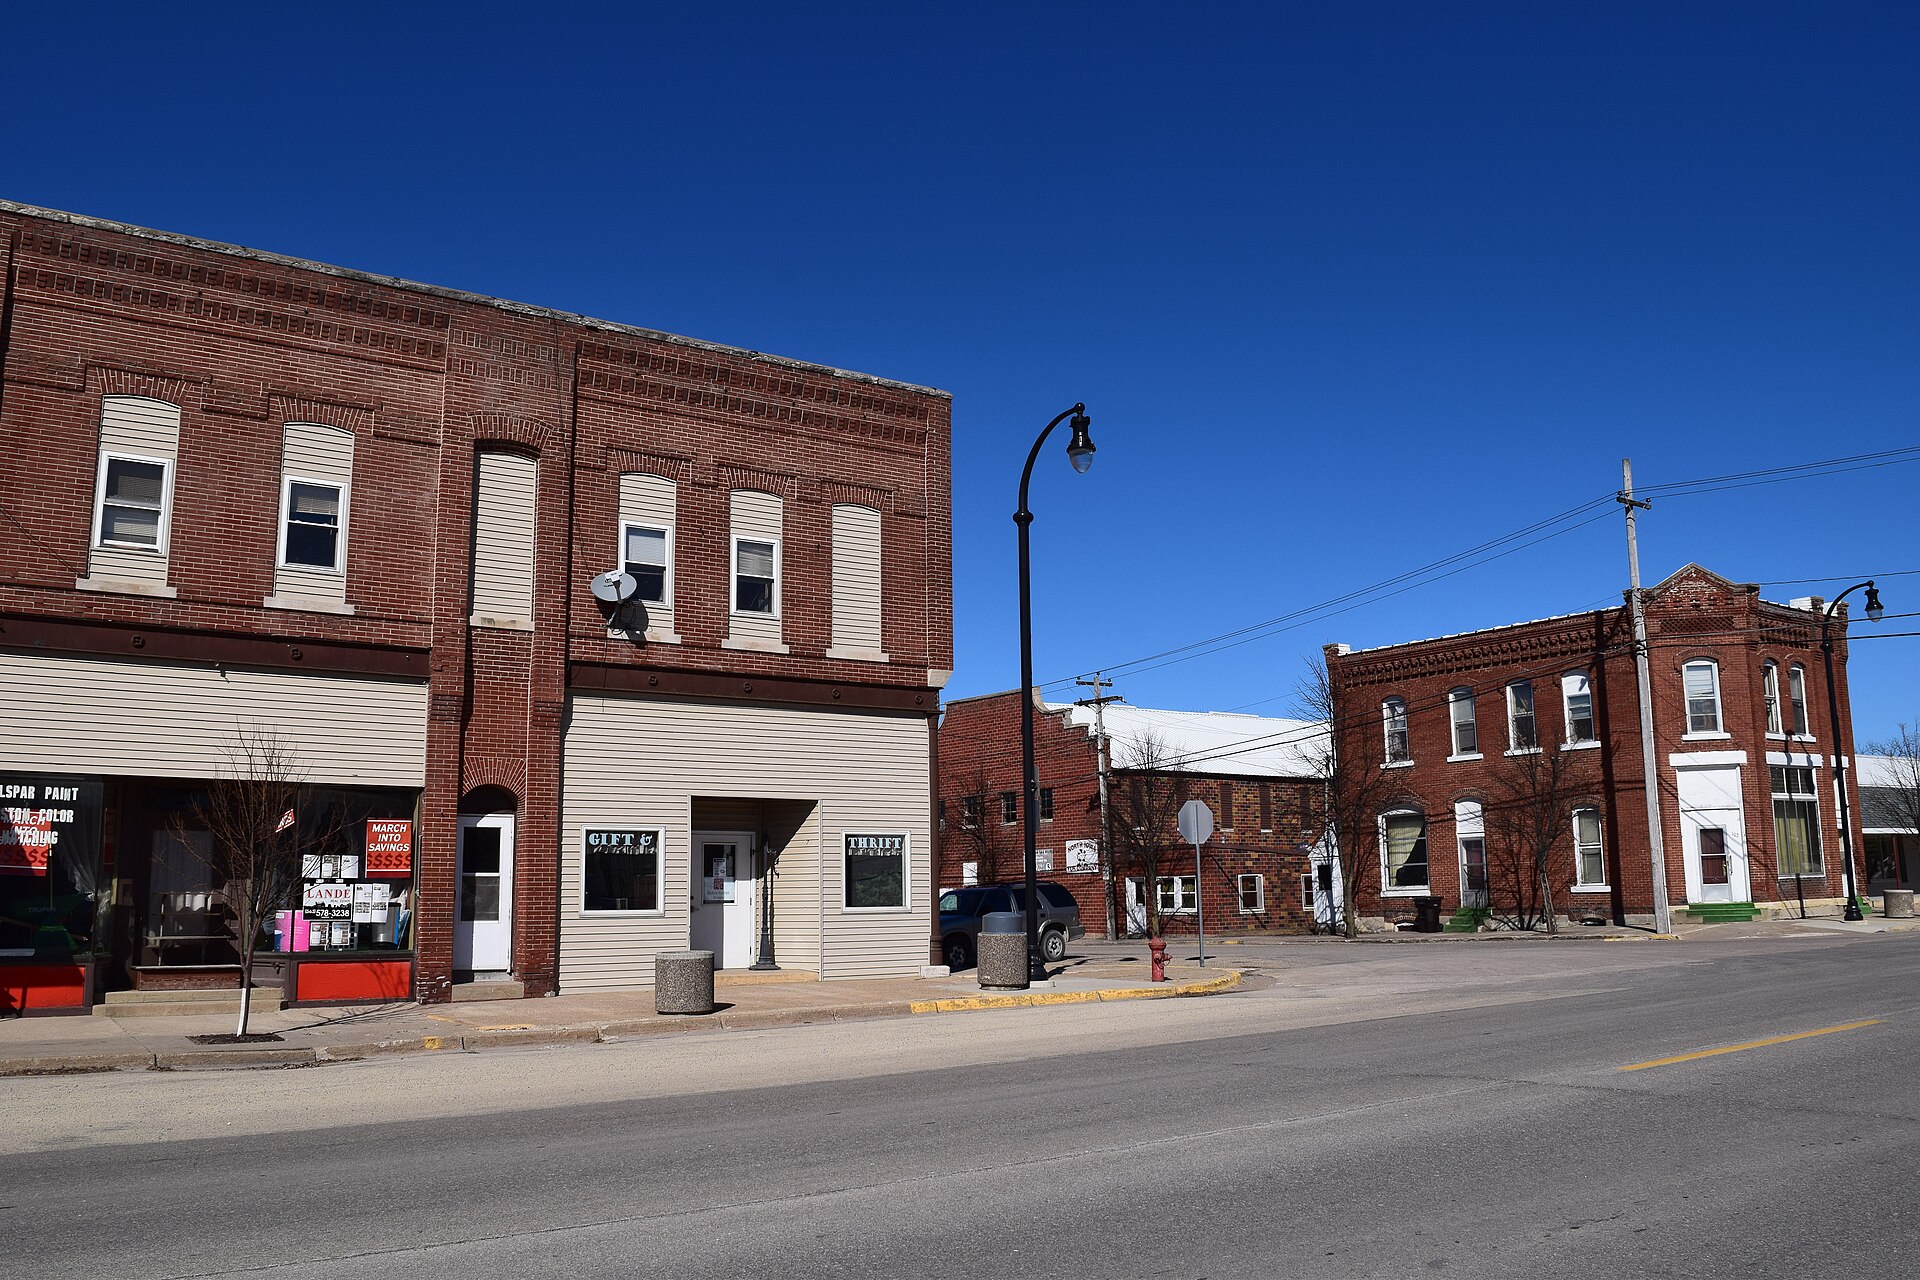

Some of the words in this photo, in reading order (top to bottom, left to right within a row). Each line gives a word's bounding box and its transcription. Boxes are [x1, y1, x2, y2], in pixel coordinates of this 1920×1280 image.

[0, 785, 35, 799] LSPAR
[45, 786, 79, 801] PAINT
[39, 808, 74, 823] COLOR
[372, 823, 407, 833] MARCH
[378, 833, 401, 842] INTO
[588, 832, 635, 846] GIFT
[639, 833, 653, 846] &
[368, 843, 410, 852] SAVINGS
[847, 837, 902, 849] THRIFT
[307, 889, 351, 899] LANDE
[315, 909, 350, 917] 578-3238
